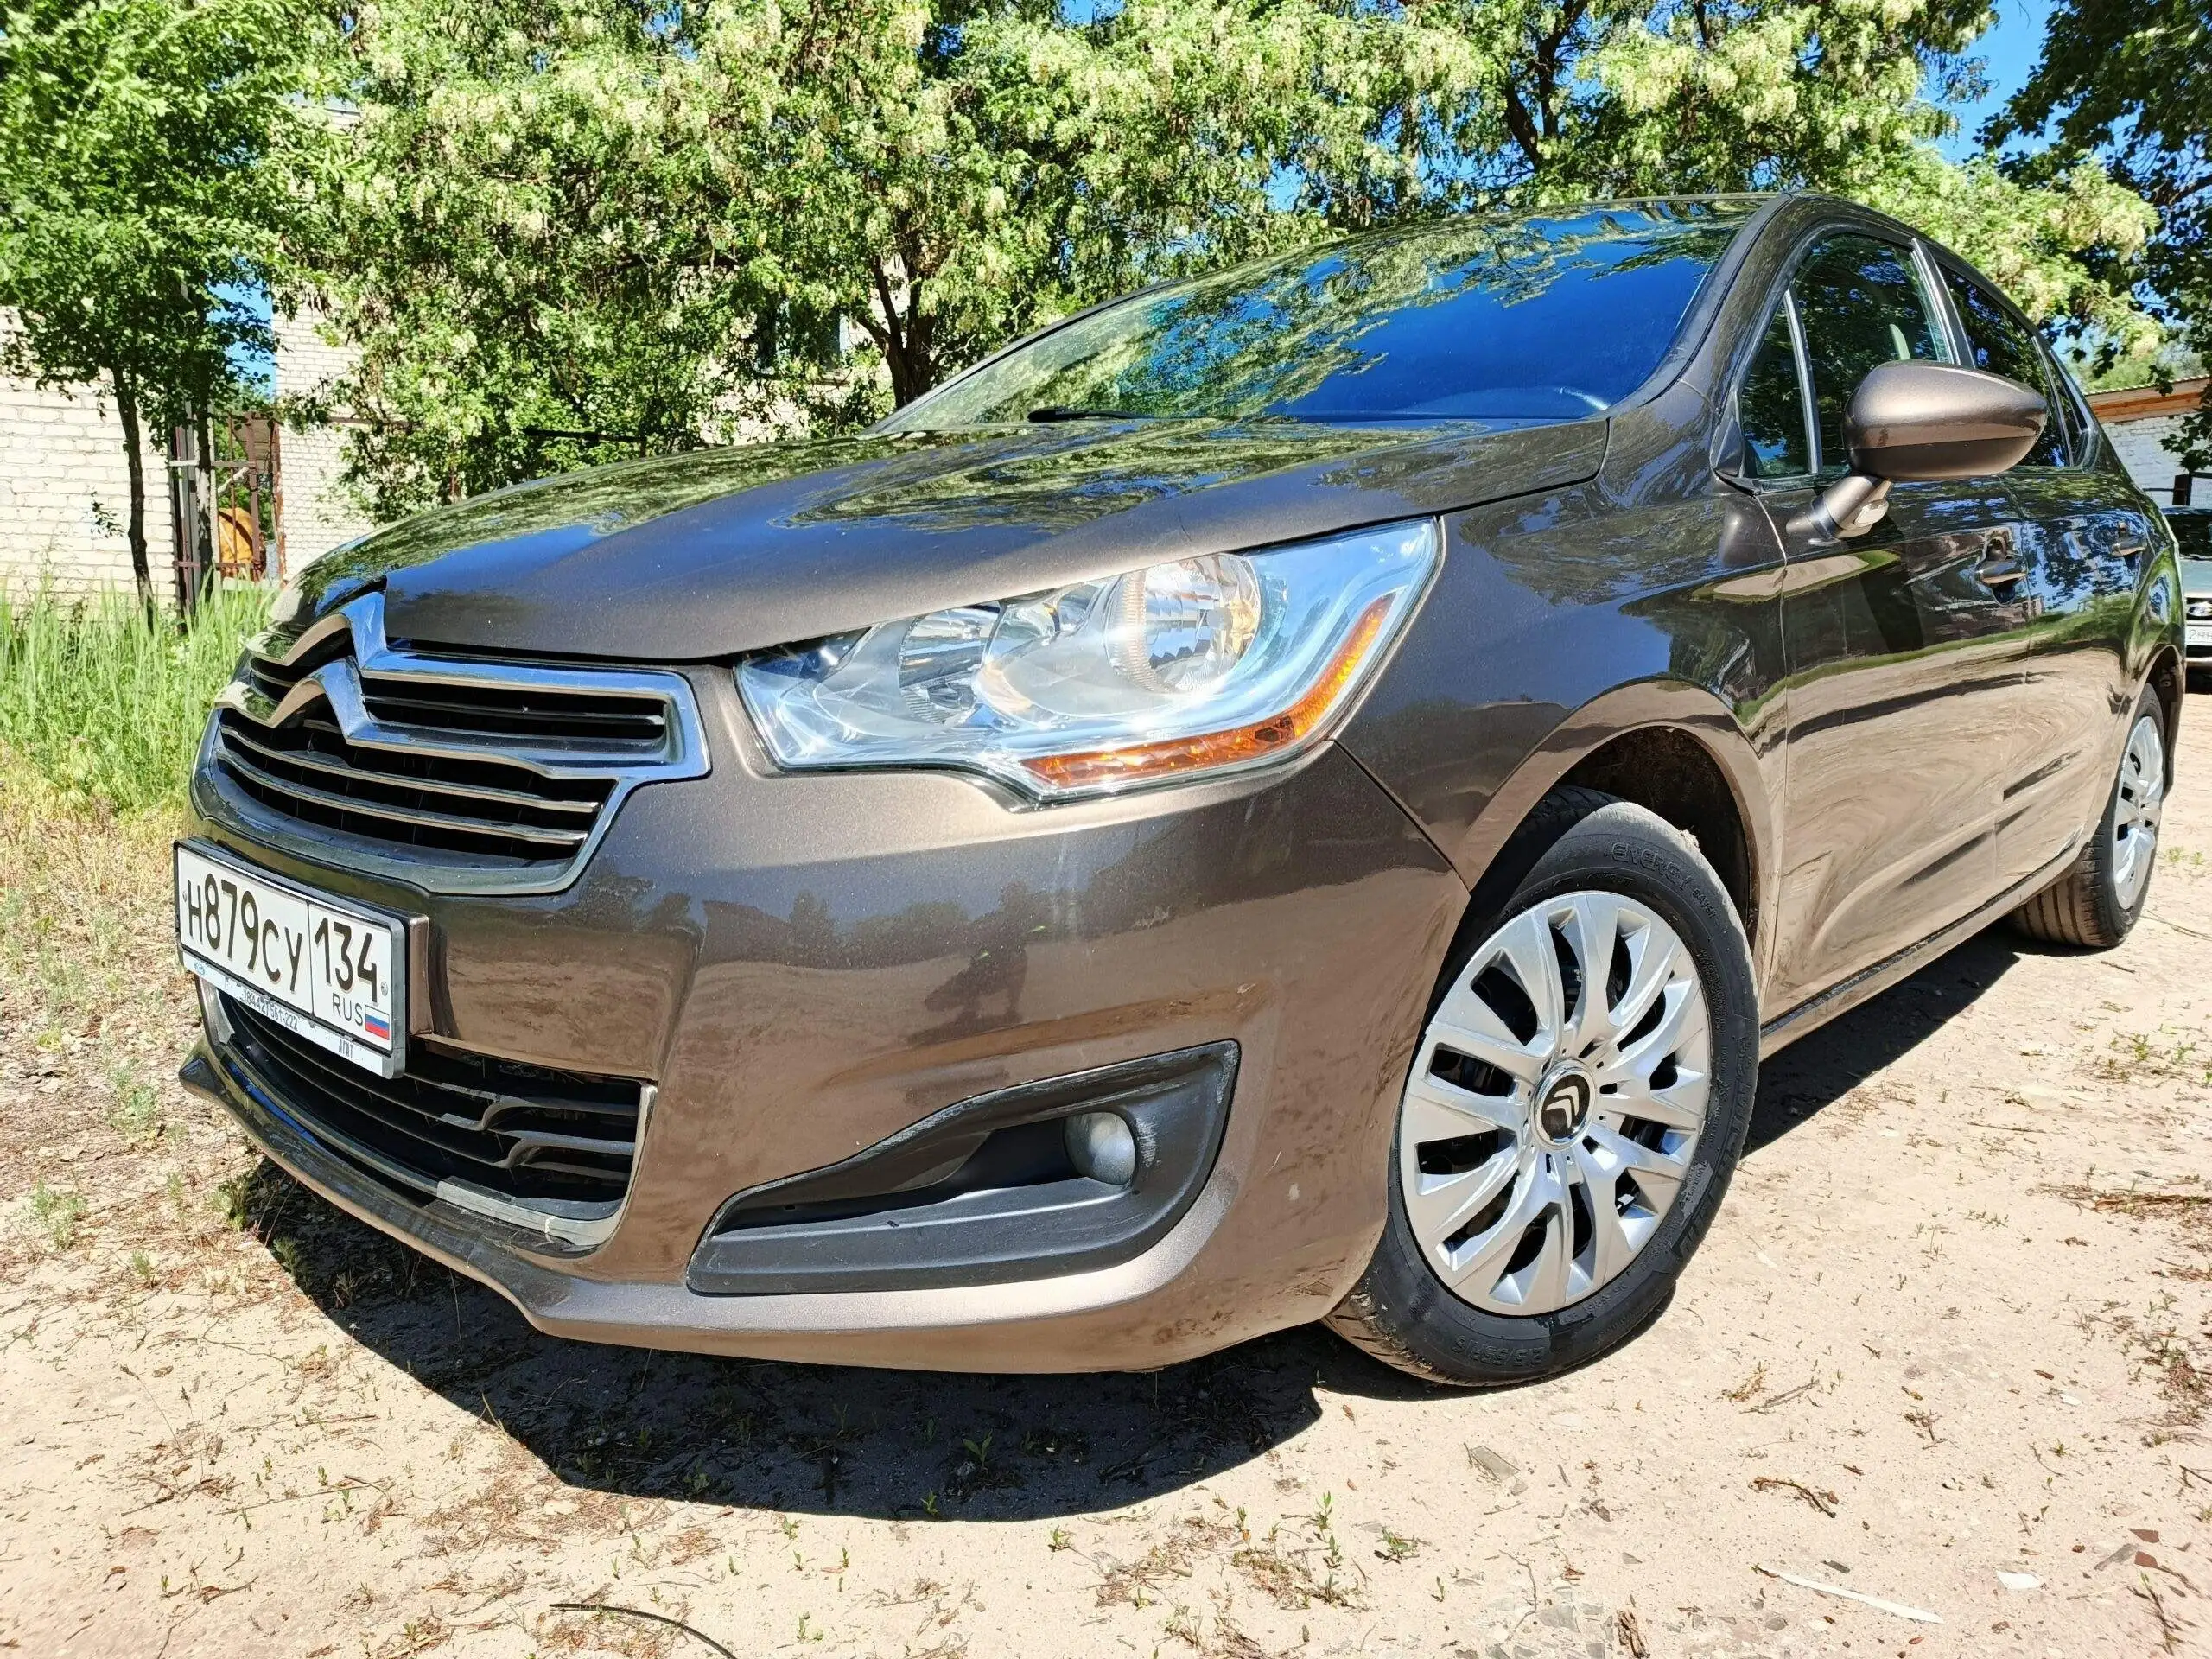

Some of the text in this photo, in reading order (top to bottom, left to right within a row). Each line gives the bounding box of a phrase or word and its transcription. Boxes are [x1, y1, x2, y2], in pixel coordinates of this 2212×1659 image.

[1611, 842, 1696, 890] ENERGY
[314, 918, 377, 1003] 134
[332, 992, 363, 1026] RUS
